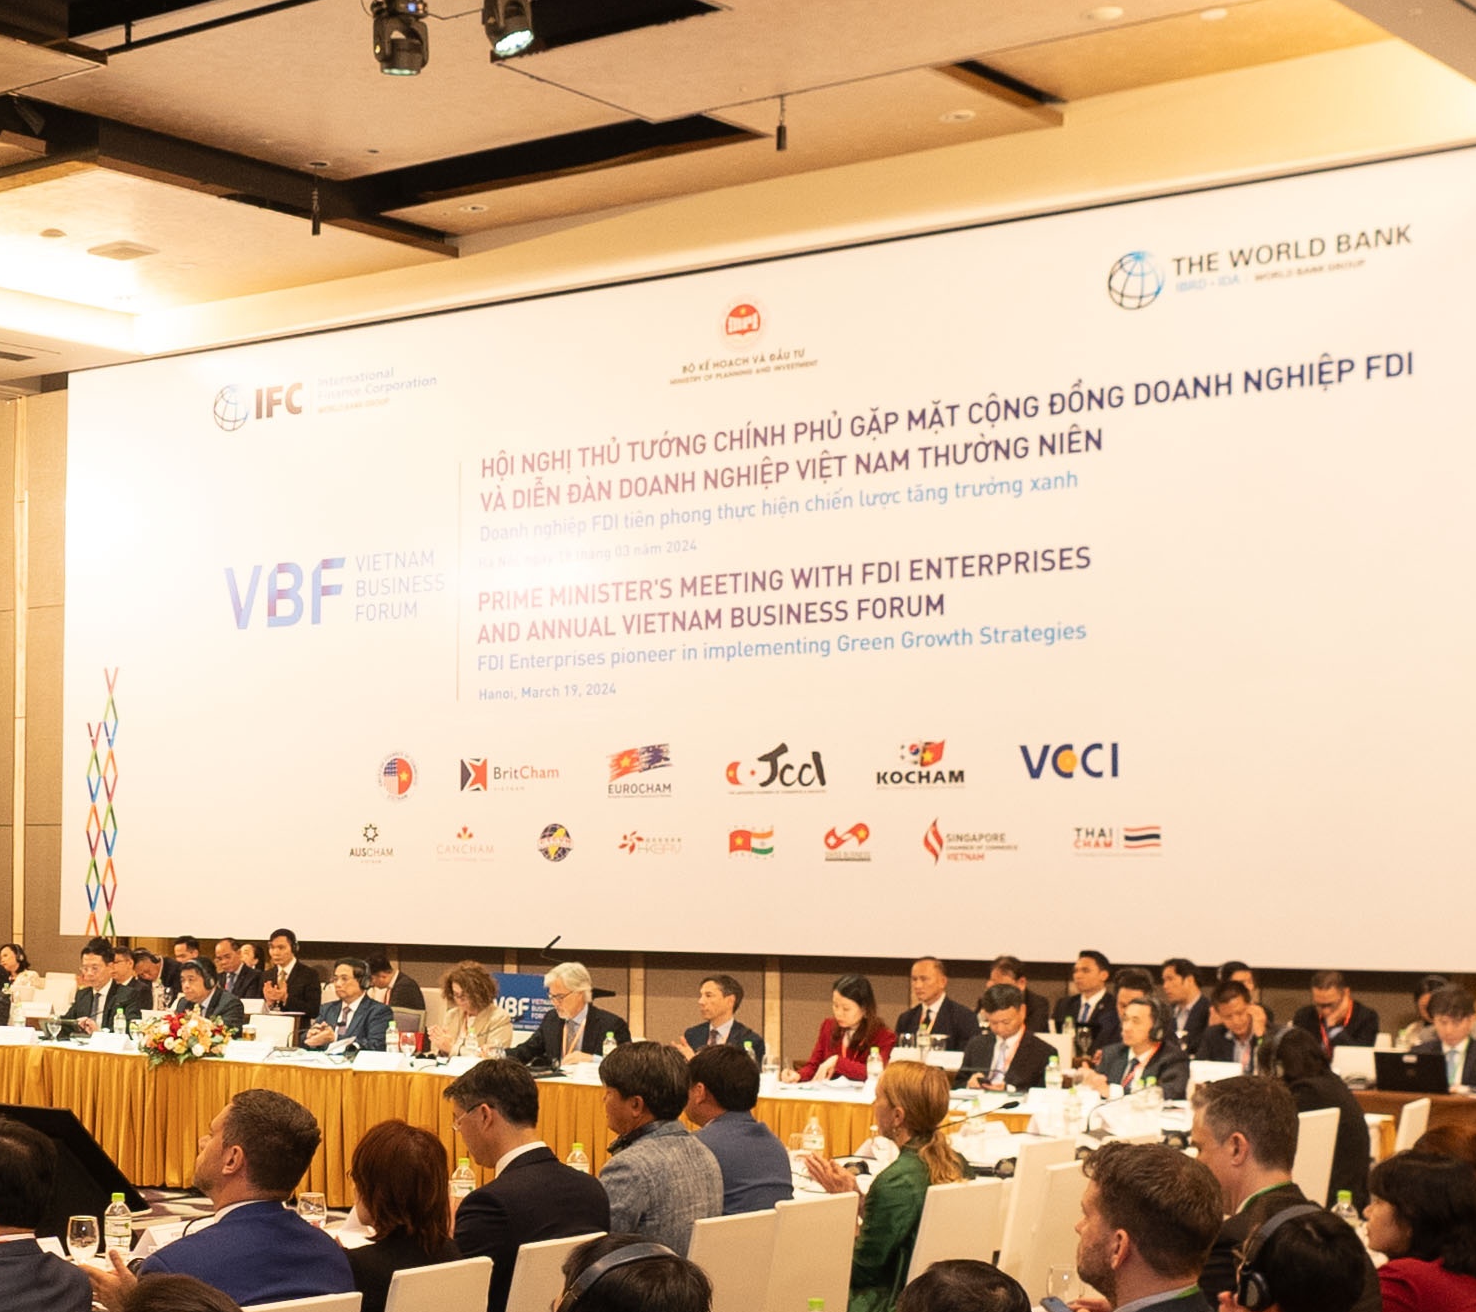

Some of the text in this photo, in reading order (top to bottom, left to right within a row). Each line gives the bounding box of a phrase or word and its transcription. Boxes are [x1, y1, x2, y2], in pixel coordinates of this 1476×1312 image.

[1172, 224, 1412, 277] THE WORLD BANK
[365, 376, 437, 395] Corporation
[255, 382, 302, 420] IFC
[481, 450, 515, 481] HỘI
[522, 449, 572, 474] NGHỊ
[578, 436, 620, 468] THỦ
[628, 430, 706, 462] TƯỚNG
[714, 421, 785, 451] CHÍNH
[794, 410, 842, 443] PHỦ
[850, 407, 899, 441] GẶP
[908, 400, 959, 434] MẶT
[968, 393, 1039, 428] CỘNG
[1135, 373, 1232, 405] DOANH
[1244, 353, 1355, 393] NGHIỆP
[1366, 351, 1413, 379] FDI
[481, 424, 1103, 512] VÀ DIỄN ĐÀN DOANH NGHIỆP VIỆT NAM THƯỜNG NIÊN
[480, 525, 528, 542] Doanh
[592, 515, 619, 532] FDI
[624, 509, 654, 529] tiên
[660, 507, 711, 530] phong
[762, 494, 799, 516] hiện
[805, 487, 853, 513] chiến
[1030, 471, 1078, 491] xanh
[614, 545, 630, 558] 03
[666, 540, 698, 554] 2024
[356, 550, 434, 572] VIETNAM
[356, 573, 445, 597] BUSINESS
[478, 546, 1091, 612] PRIME MINISTER'S MEETING WITH FDI ENTERPRISES
[223, 557, 346, 629] VBF
[355, 601, 417, 622] FORUM
[478, 593, 945, 644] AND ANNUAL VIETNAM BUSINESS FORUM
[478, 621, 1087, 671] FDI Enterprises pioneer in implementing Green Growth Strategies
[478, 683, 617, 702] Hanoi, March 19, 2024
[1019, 742, 1118, 779] VCCI
[493, 766, 559, 780] BritCham
[876, 770, 965, 785] KOCHAM
[608, 783, 672, 794] EUROCHAM
[946, 833, 1005, 842] SINGAPORE
[1075, 828, 1112, 837] THAI
[349, 847, 394, 857] AUSCHAM
[436, 844, 494, 854] CANCHAM
[1074, 840, 1112, 848] CHAM
[946, 853, 985, 861] VIETNAM
